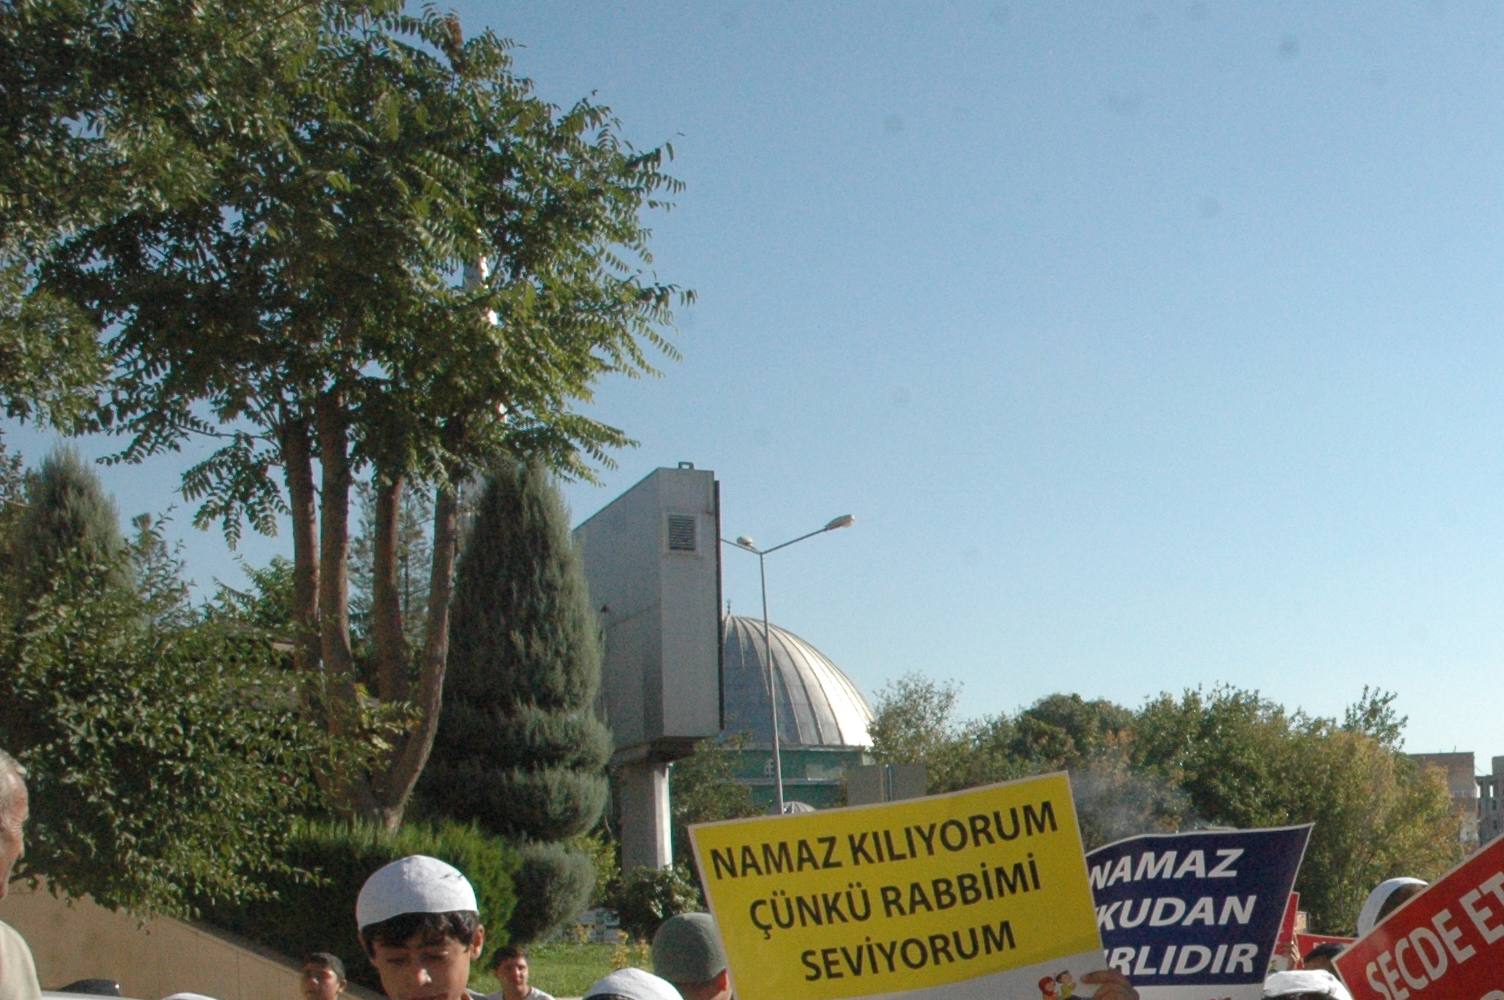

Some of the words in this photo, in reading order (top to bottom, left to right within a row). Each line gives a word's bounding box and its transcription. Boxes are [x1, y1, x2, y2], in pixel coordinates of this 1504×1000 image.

[710, 836, 843, 881] NAMAZ
[848, 801, 1059, 867] KILIYORUM
[1089, 848, 1245, 891] NAMAZ
[750, 881, 872, 940] ÇÜNKÜ
[880, 852, 1042, 918] RABBİMİ
[1096, 895, 1257, 932] KUDAN
[801, 920, 1017, 982] SEVİYORUM
[1104, 943, 1258, 976] RLIDIR
